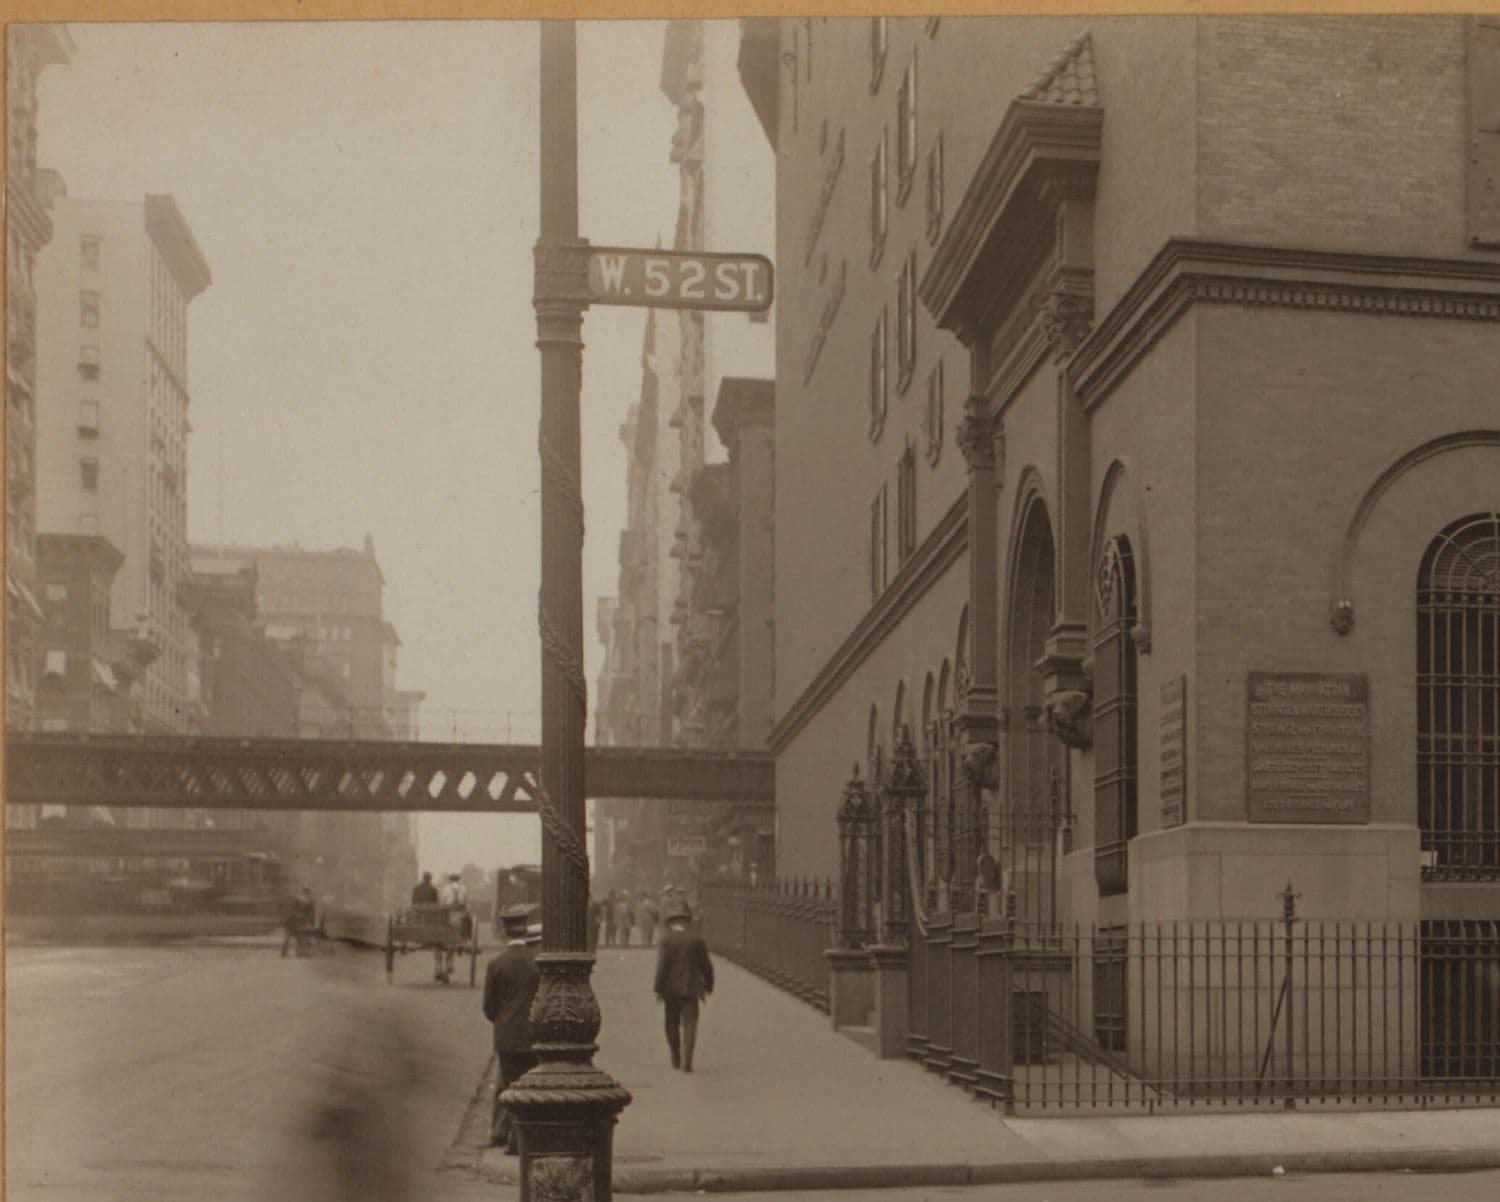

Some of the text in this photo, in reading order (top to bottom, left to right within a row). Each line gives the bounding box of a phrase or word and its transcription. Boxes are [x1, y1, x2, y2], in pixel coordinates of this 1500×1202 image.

[598, 254, 763, 301] W. 52 ST.
